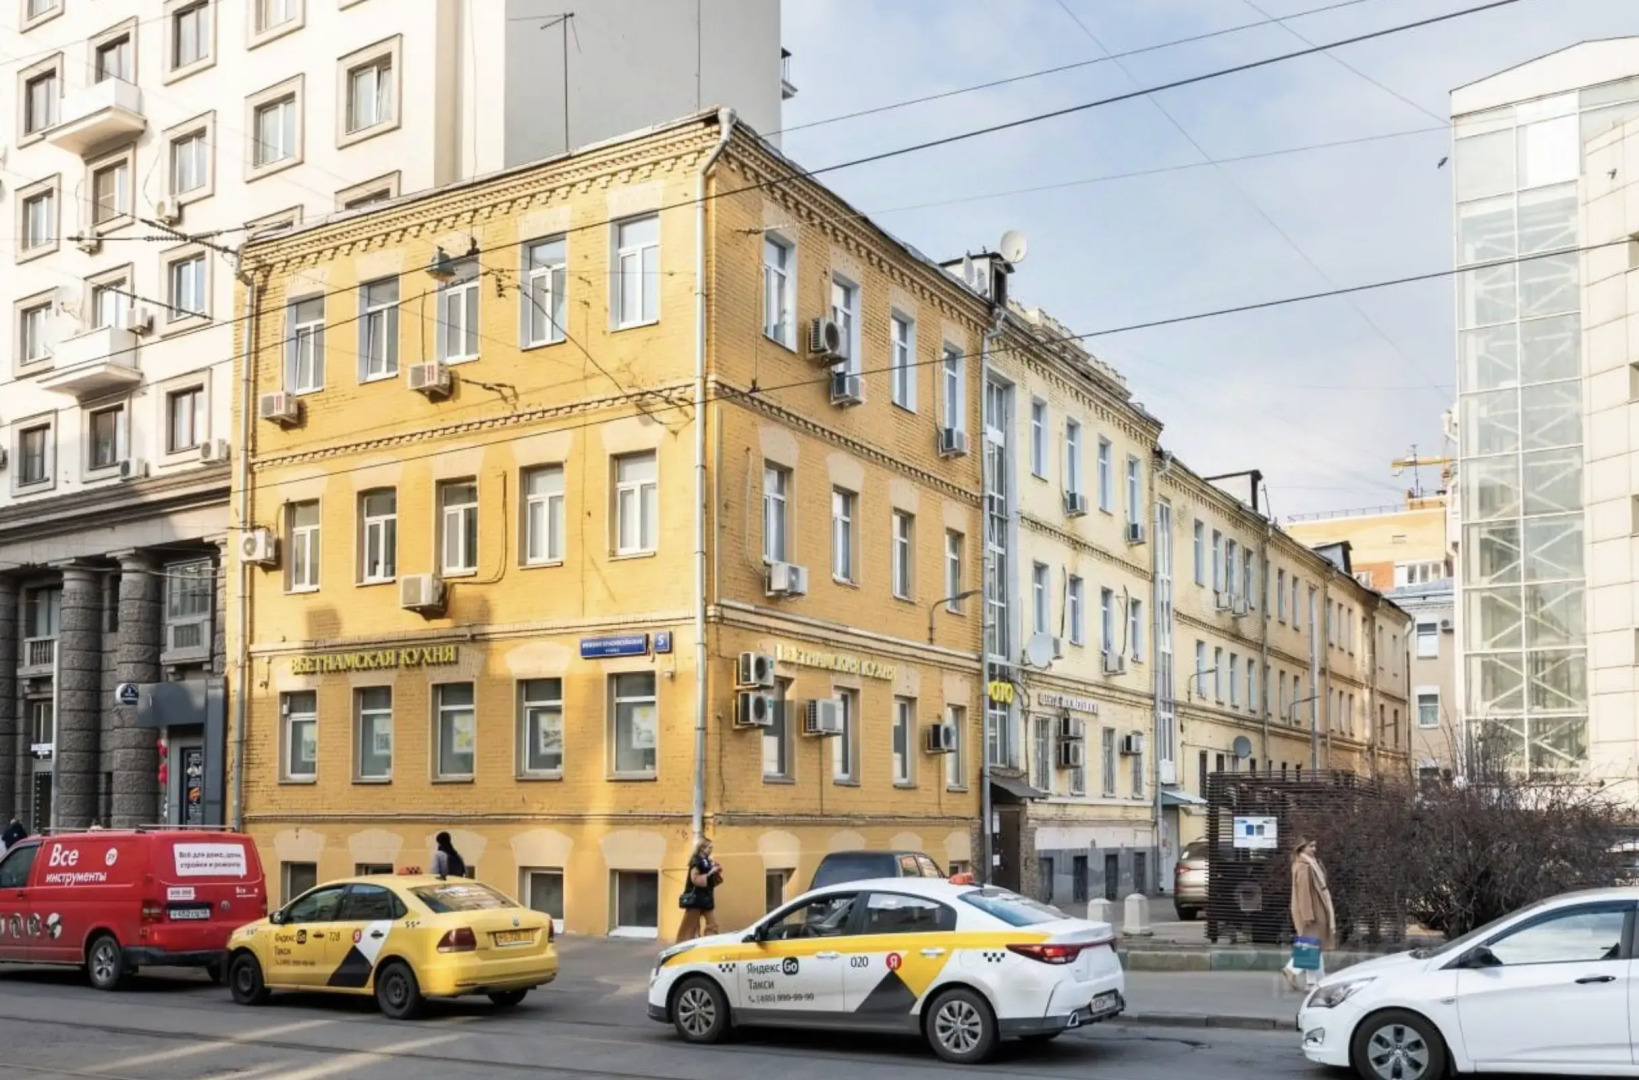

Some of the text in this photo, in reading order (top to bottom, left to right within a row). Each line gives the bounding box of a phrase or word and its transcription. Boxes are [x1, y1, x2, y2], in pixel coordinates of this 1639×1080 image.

[658, 635, 664, 646] 5
[291, 646, 457, 673] ВЬЕТНАМСКАЯ КУХНЯ
[49, 843, 79, 867] Все
[45, 871, 107, 887] инструменты
[329, 931, 341, 942] 728
[746, 959, 798, 976] Яндекс Go
[850, 956, 869, 968] 020
[889, 955, 898, 968] Я
[747, 978, 775, 990] Такси
